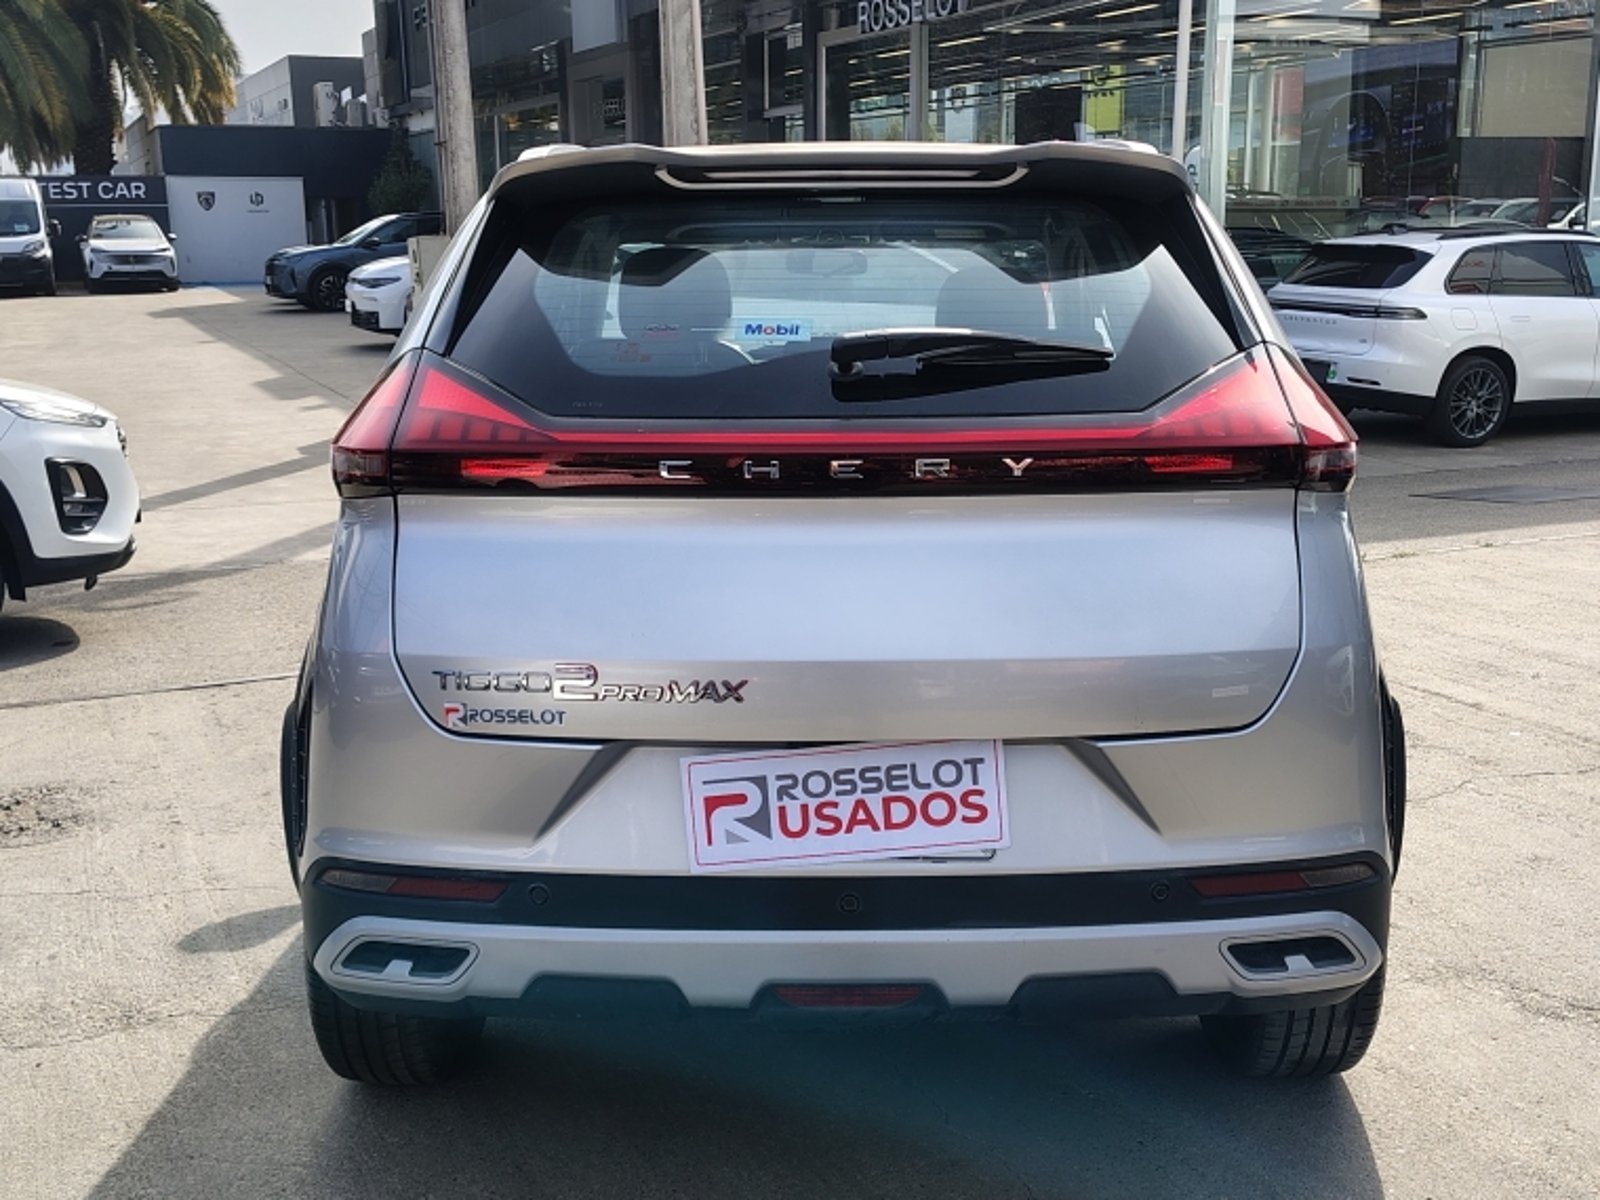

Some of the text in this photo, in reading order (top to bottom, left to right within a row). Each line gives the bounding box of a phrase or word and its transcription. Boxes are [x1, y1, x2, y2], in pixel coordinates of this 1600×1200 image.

[98, 181, 146, 199] CAR
[744, 323, 800, 336] Mobil
[658, 457, 1034, 480] CHERY
[468, 708, 566, 725] ROSSELOT
[775, 757, 985, 802] ROSSELOT
[778, 789, 989, 839] USADOS
